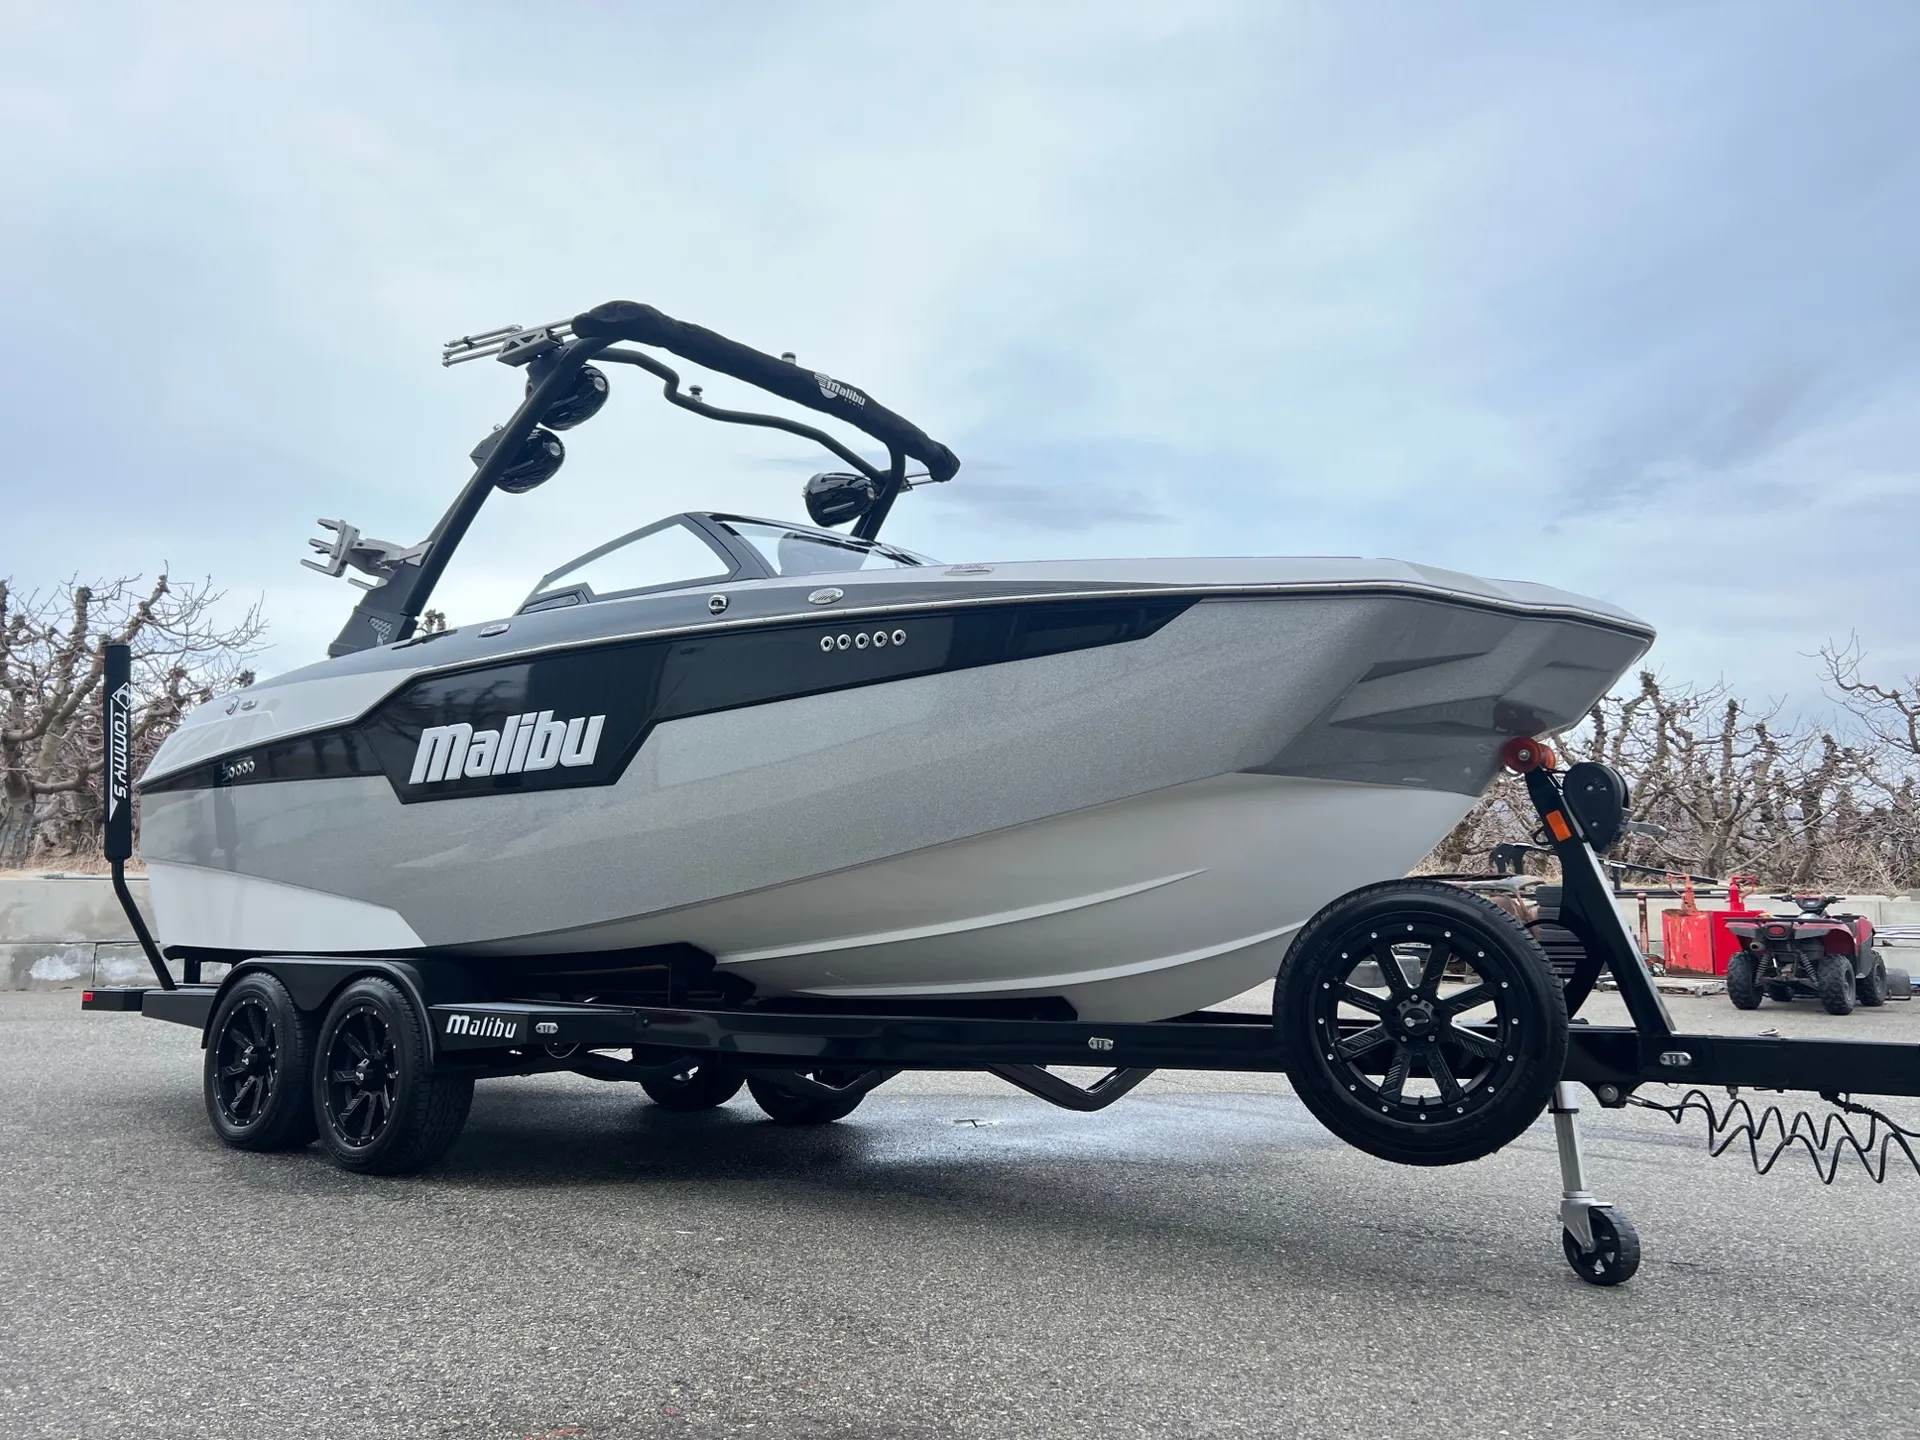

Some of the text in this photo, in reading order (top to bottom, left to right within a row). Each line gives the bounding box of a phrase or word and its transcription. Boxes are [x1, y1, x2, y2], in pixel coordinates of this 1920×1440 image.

[826, 380, 866, 406] Malibu
[409, 710, 606, 785] Malibu
[445, 1014, 517, 1039] Malibu
